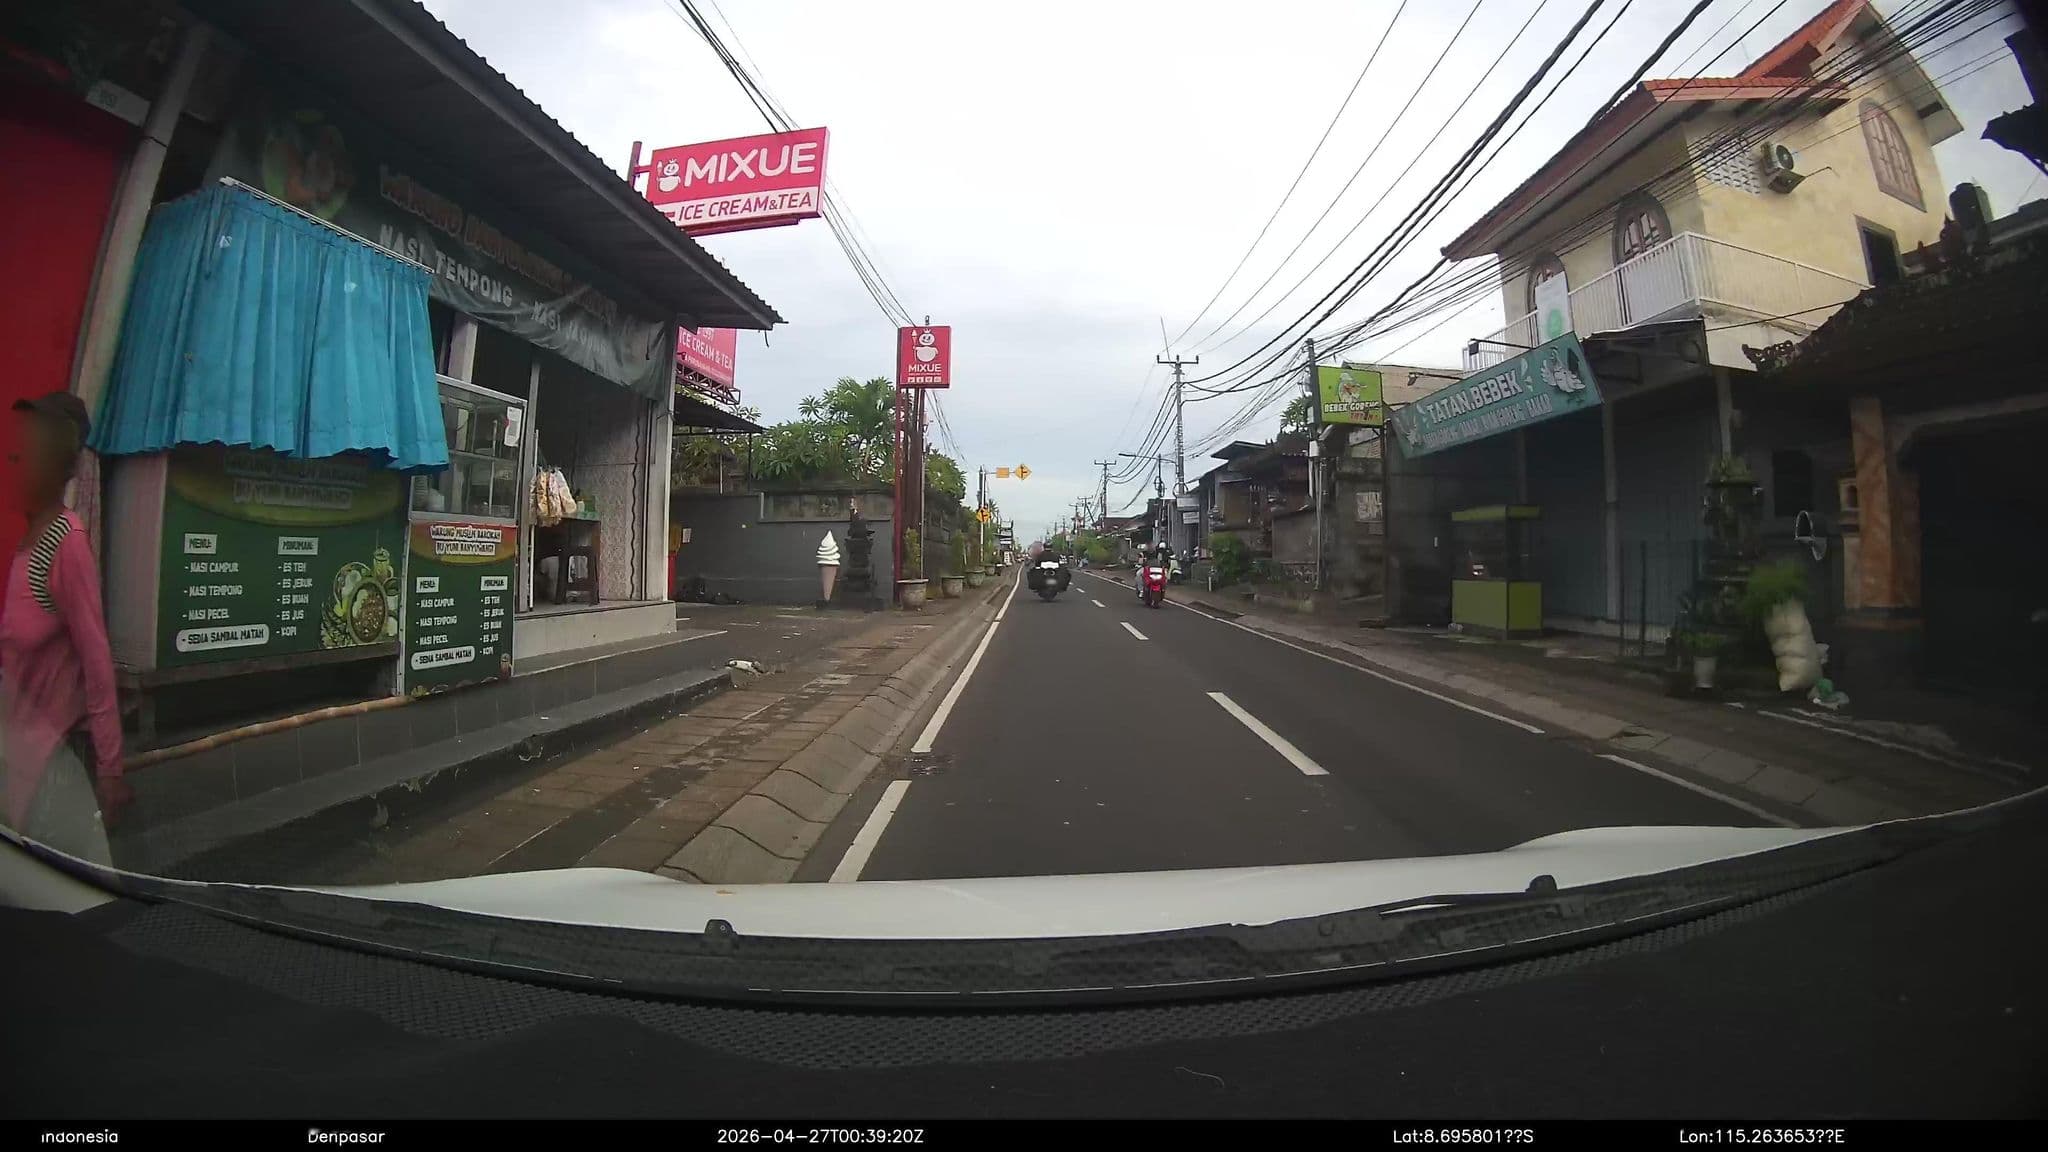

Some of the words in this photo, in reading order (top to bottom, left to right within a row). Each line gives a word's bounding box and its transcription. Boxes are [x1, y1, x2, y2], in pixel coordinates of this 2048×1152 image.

[684, 142, 818, 187] MIXUE
[679, 203, 705, 221] ICE
[379, 224, 425, 262] NASI
[434, 250, 513, 308] TEMPONG
[530, 300, 562, 331] NASI
[679, 330, 691, 349] ICE
[692, 336, 715, 362] CREAM
[721, 353, 733, 370] TEA
[908, 363, 942, 373] MIXUE
[1324, 403, 1348, 413] BEBEK
[190, 562, 208, 573] NASI
[209, 561, 239, 573] CAMPUR
[283, 562, 292, 572] ES
[293, 562, 306, 572] TEH
[282, 578, 291, 588] ES
[292, 578, 313, 589] JERUK
[189, 585, 207, 597] NASI
[207, 584, 243, 596] TEMPONG
[282, 594, 291, 604] ES
[420, 598, 433, 608] NASI
[433, 597, 455, 607] CAMPUR
[484, 596, 491, 605] ES
[188, 609, 206, 620] NASI
[207, 608, 230, 620] PECEL
[281, 610, 290, 620] ES
[292, 609, 304, 620] JUS
[484, 608, 490, 617] ES
[420, 617, 432, 627] NASI
[433, 615, 457, 626] TEMPONG
[483, 621, 490, 630] ES
[188, 633, 208, 645] SEDIA
[210, 630, 239, 643] SAMBAL
[240, 628, 264, 641] MATAH
[281, 626, 296, 637] KOPI
[420, 635, 432, 645] NASI
[433, 634, 448, 645] PECEL
[483, 634, 490, 643] ES
[419, 655, 434, 665] SEDIA
[456, 649, 472, 659] MATAH
